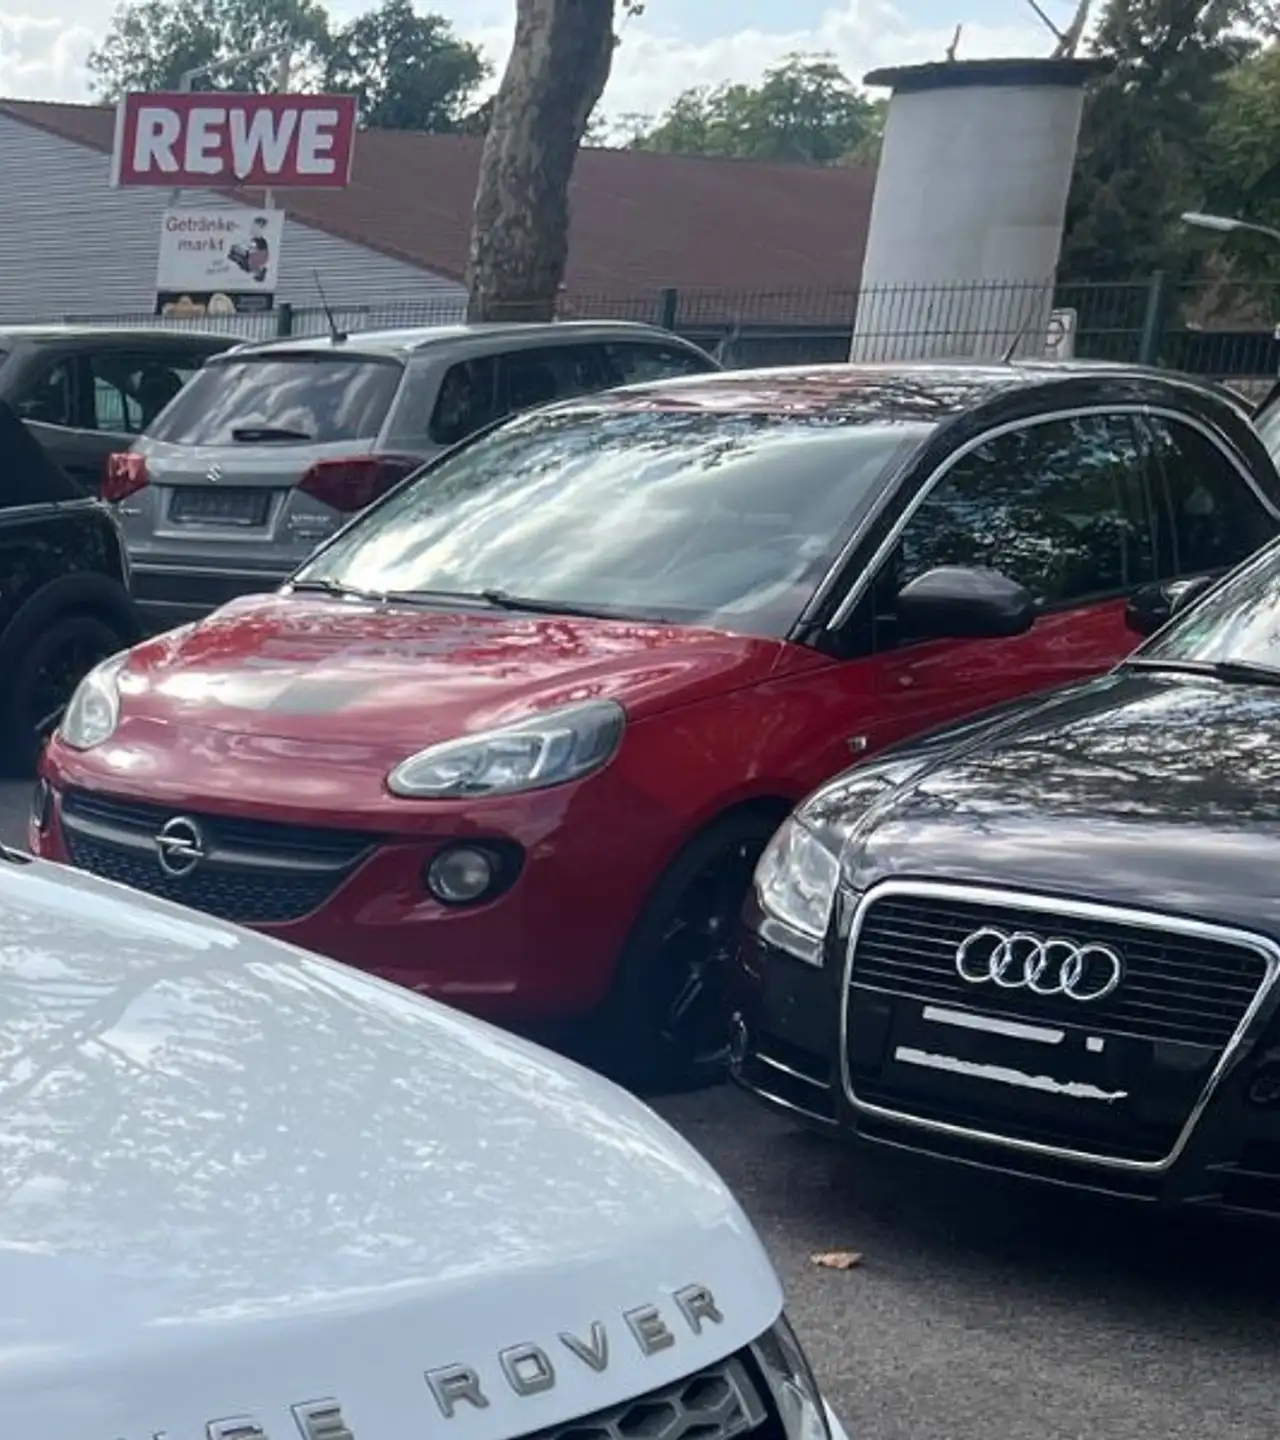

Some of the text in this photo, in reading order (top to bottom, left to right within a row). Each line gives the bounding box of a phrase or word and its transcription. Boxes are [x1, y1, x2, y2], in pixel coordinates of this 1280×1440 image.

[133, 107, 339, 180] REWE
[178, 237, 224, 251] markt
[423, 1283, 724, 1419] ROVER
